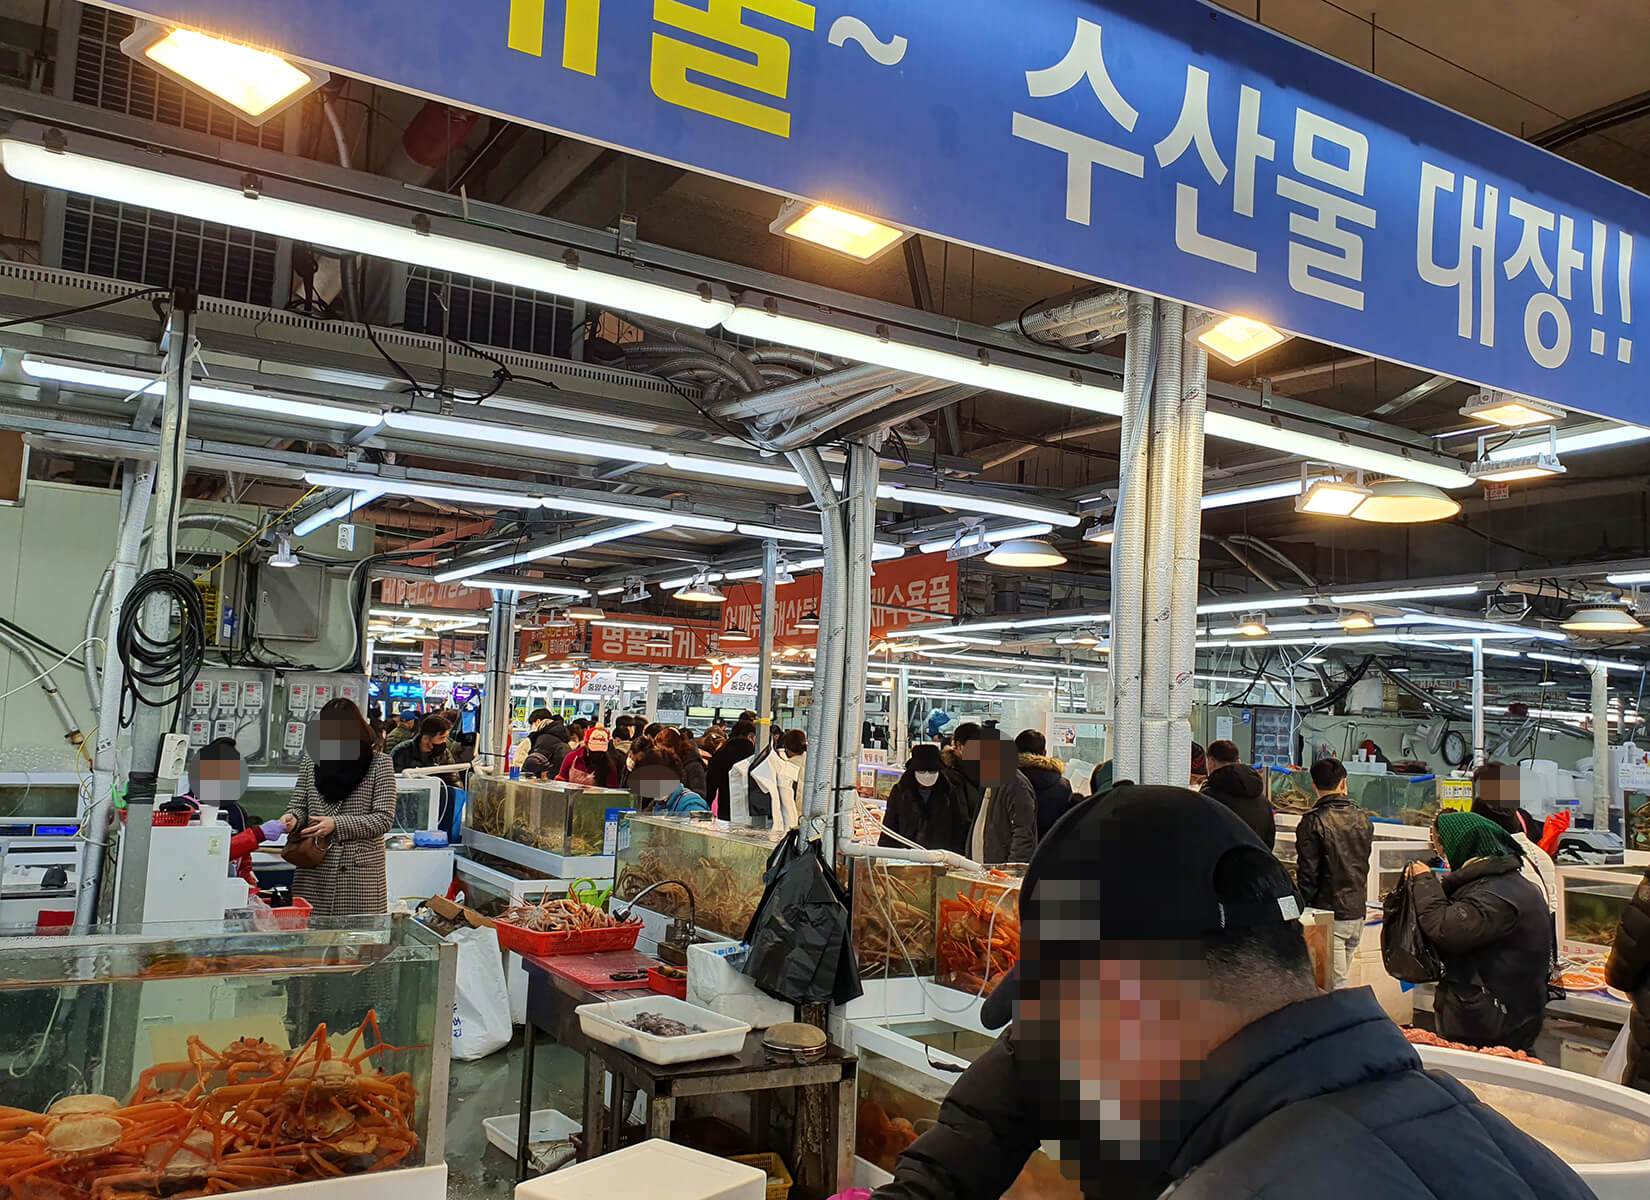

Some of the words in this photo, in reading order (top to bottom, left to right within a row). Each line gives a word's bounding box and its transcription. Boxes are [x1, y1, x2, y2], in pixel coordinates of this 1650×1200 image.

[1011, 16, 1376, 311] 수산물
[1416, 160, 1633, 370] 대장!!
[726, 667, 733, 678] 5
